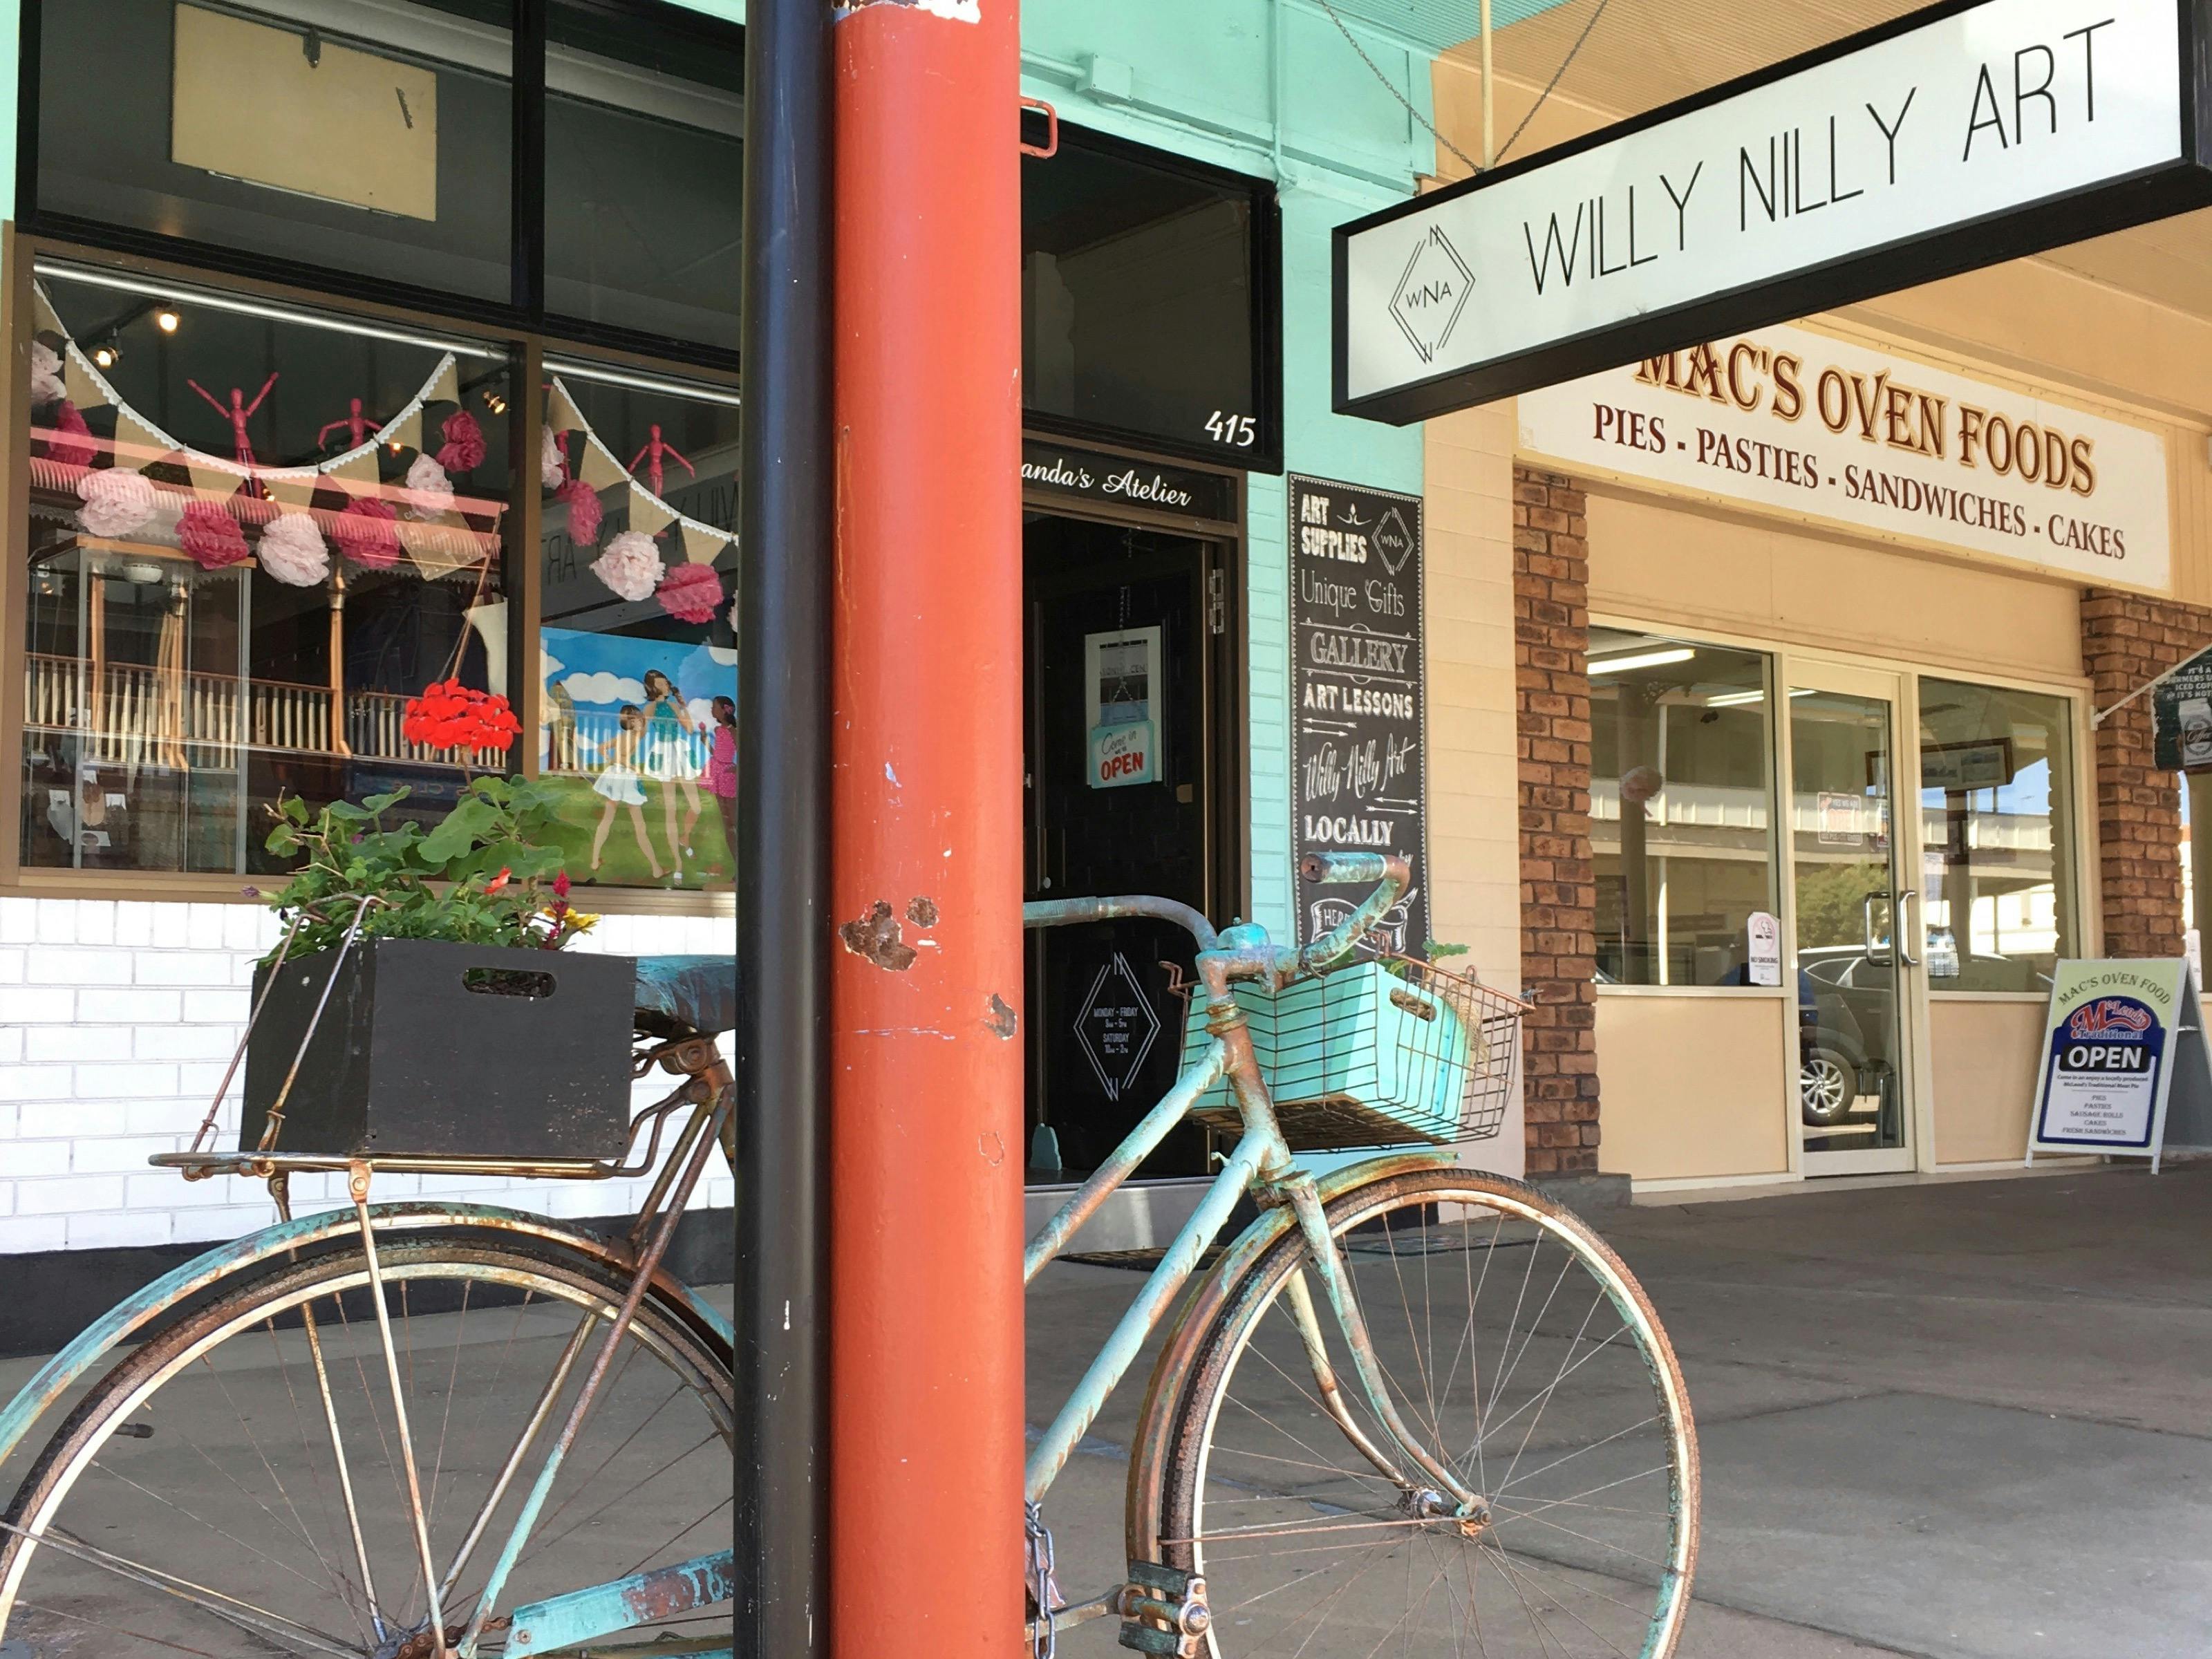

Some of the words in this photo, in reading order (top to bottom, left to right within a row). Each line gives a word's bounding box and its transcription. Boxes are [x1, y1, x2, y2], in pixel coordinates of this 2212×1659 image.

[1524, 160, 1704, 295] WILLY
[1740, 86, 1918, 232] NILLY
[1962, 18, 2115, 162] ART
[1405, 279, 1452, 310] WNA
[1204, 411, 1256, 447] 415
[1817, 366, 1951, 460] OVEN
[1958, 406, 2098, 497] FOODS
[1102, 469, 1192, 507] Atelier
[1593, 403, 1667, 453] PIES
[1696, 427, 1819, 489] PASTIES
[1844, 464, 2027, 537] SANDWICHES
[2048, 514, 2126, 559] CAKES
[1301, 494, 1329, 525] ART
[1301, 526, 1368, 564] SUPPLIES
[1301, 569, 1357, 617] Unique
[1365, 579, 1405, 617] Gifts
[1310, 631, 1408, 673] GALLERY
[1303, 683, 1338, 710] ART
[1342, 686, 1414, 720] LESSONS
[1100, 752, 1144, 780] OPEN
[1302, 742, 1340, 802] Willy
[1380, 733, 1416, 791] Art
[1304, 814, 1394, 847] LOCALLY
[2058, 976, 2099, 1006] MAC'S
[2101, 972, 2139, 986] OVEN
[2139, 977, 2171, 1004] FOOD
[2068, 1046, 2142, 1069] OPEN
